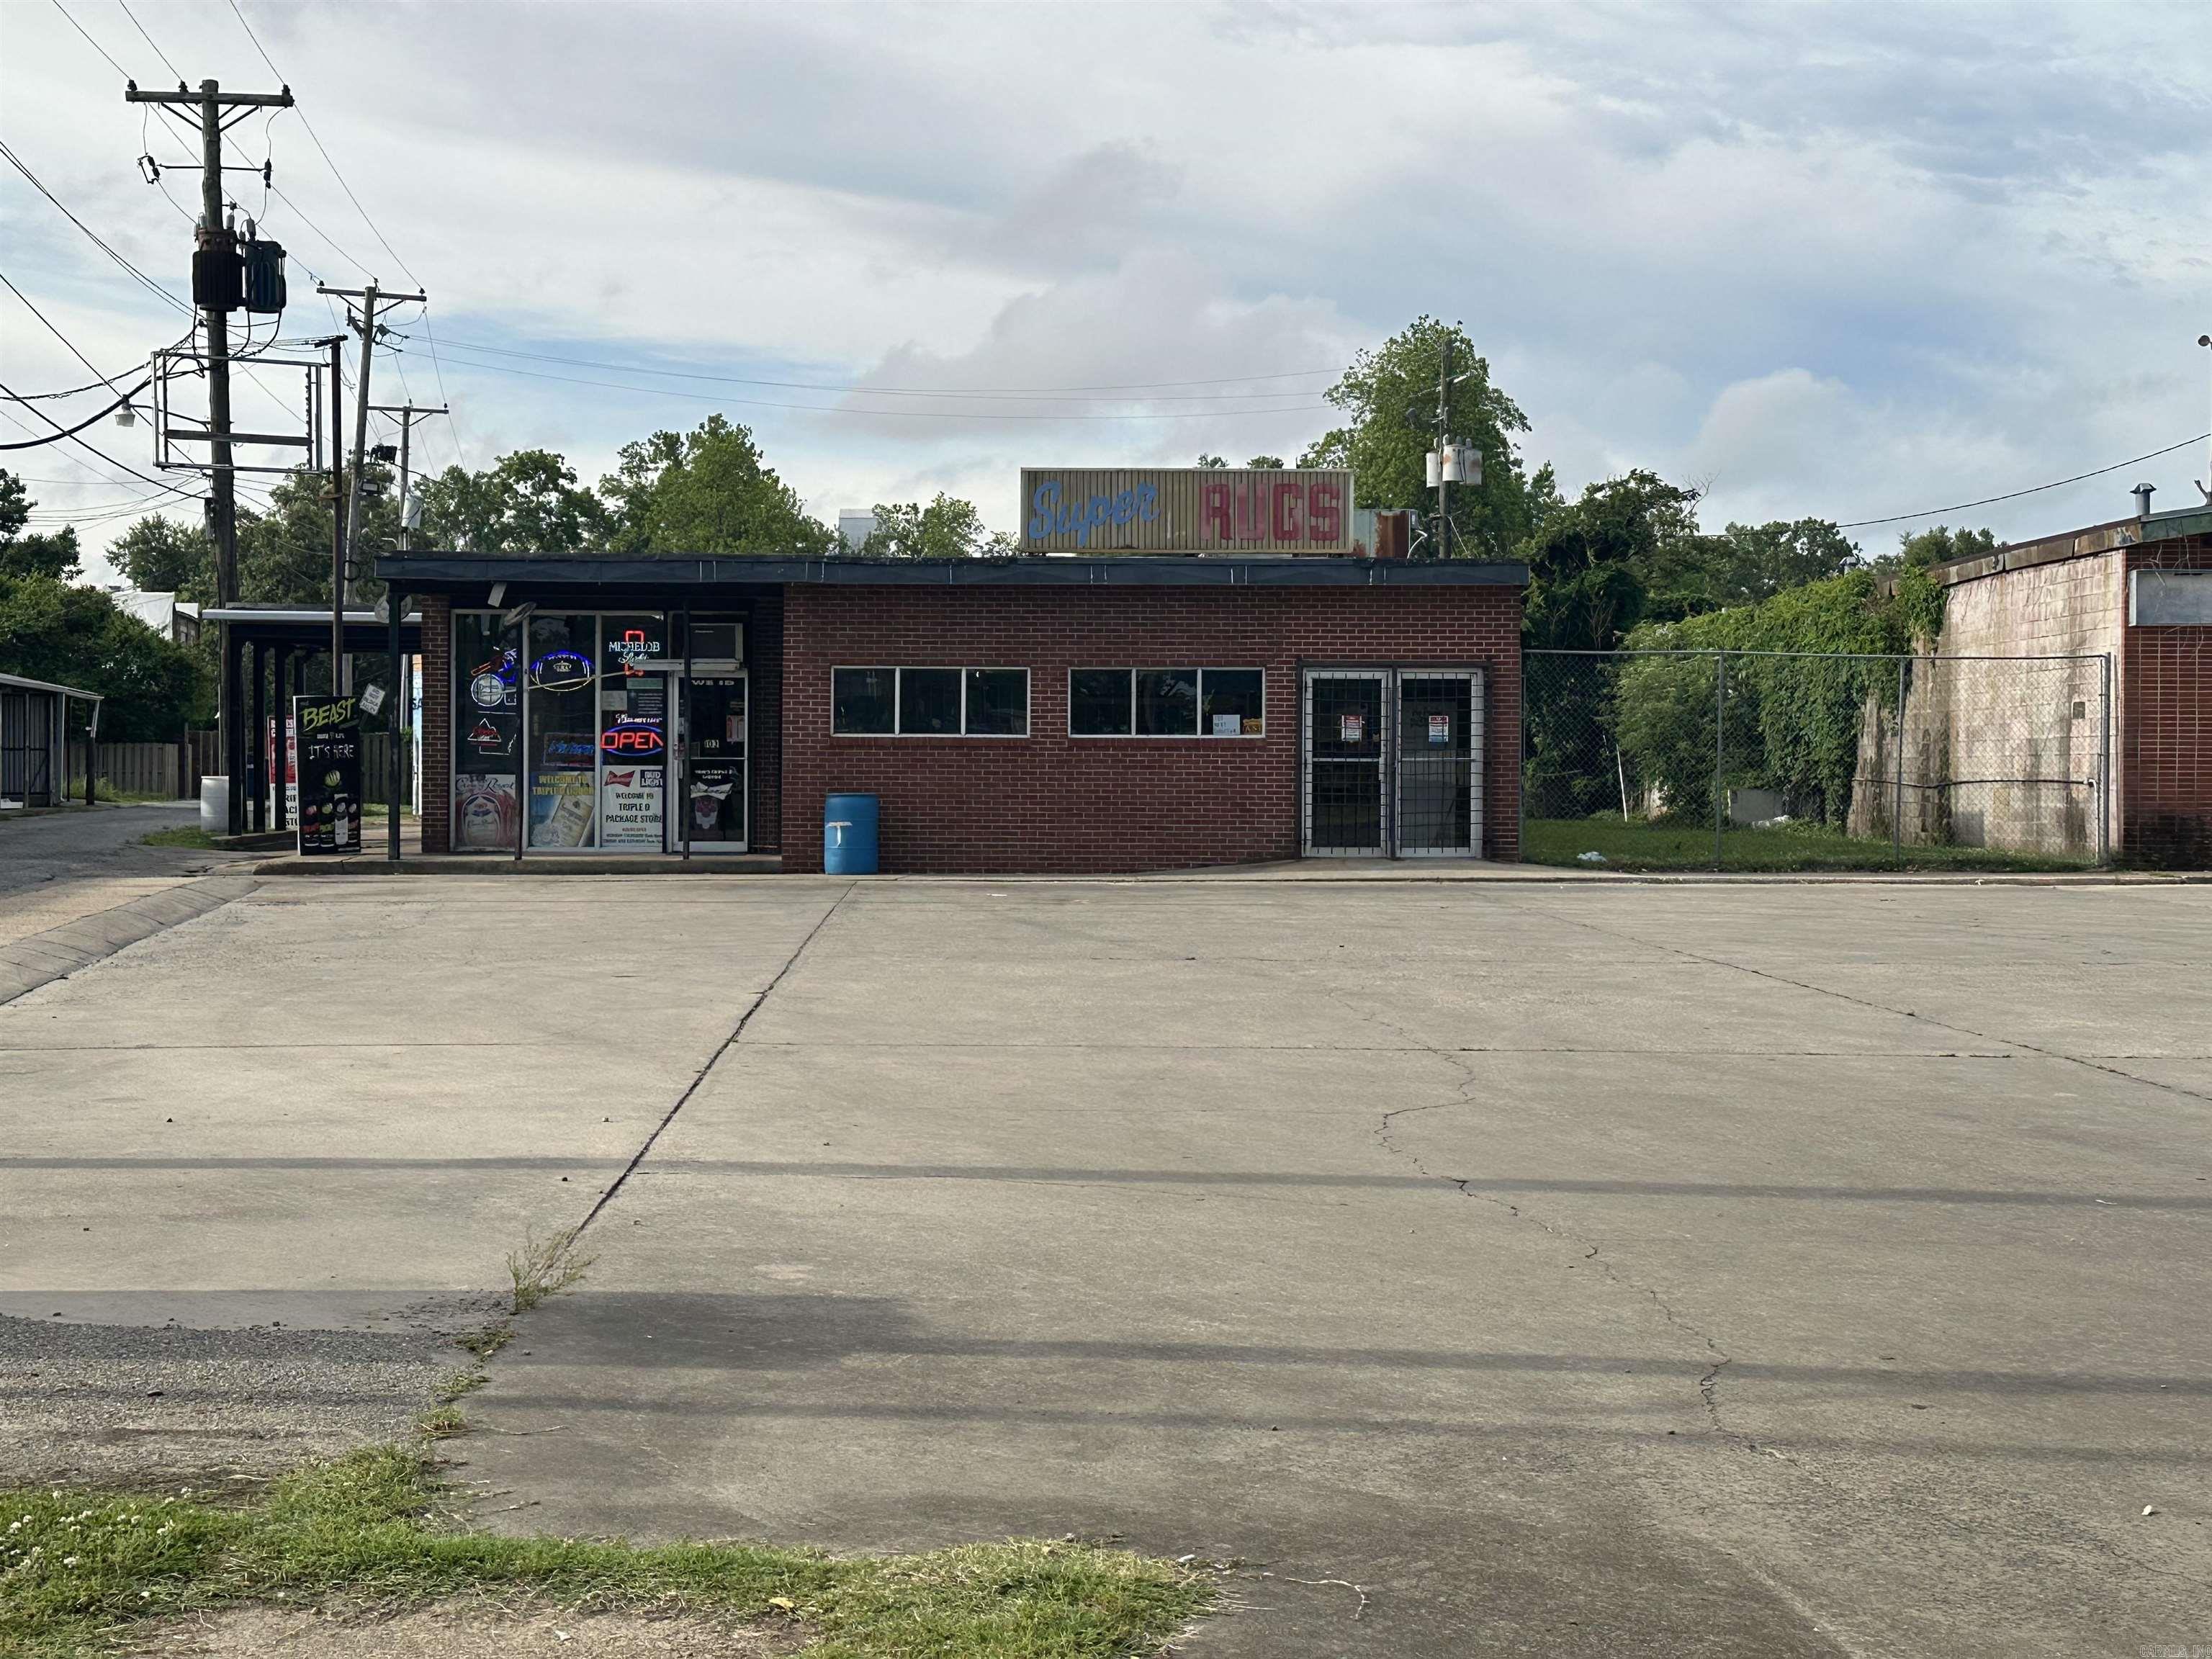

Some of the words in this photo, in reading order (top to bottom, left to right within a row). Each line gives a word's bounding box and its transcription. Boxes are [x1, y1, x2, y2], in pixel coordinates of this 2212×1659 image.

[1028, 480, 1161, 547] Super
[1200, 482, 1341, 542] RUGS
[608, 642, 660, 652] MICHELOB
[299, 698, 356, 732] BEAST
[600, 732, 664, 749] OPEN
[619, 803, 643, 811] TRIPLE
[606, 814, 639, 823] PACKAGE
